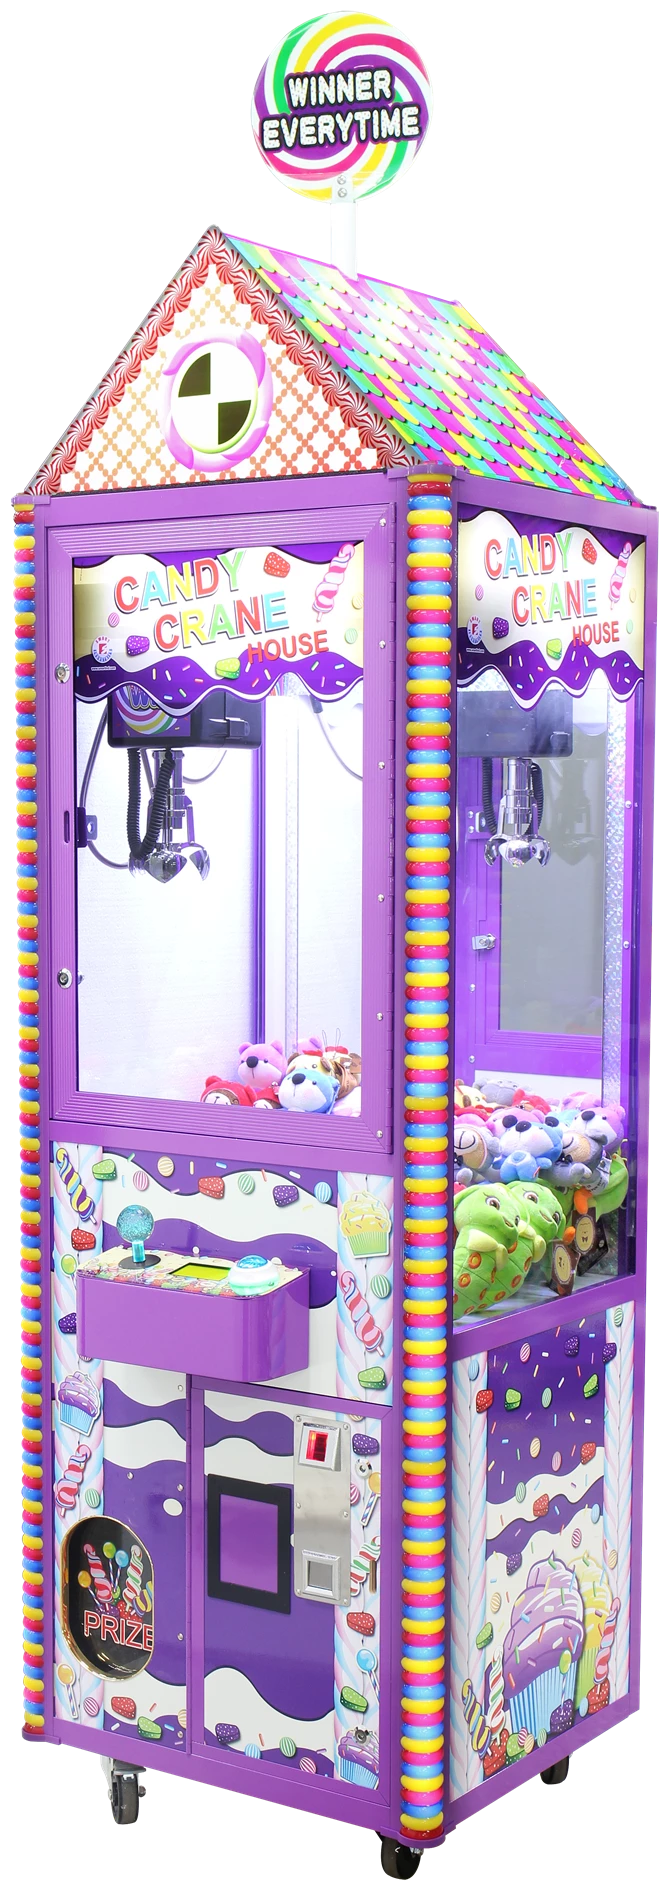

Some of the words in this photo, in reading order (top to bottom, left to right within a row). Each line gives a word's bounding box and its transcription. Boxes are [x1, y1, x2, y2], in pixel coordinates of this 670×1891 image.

[287, 69, 393, 108] WINNER
[262, 105, 421, 150] EVERYTIME
[484, 531, 574, 580] CANDY
[114, 550, 246, 614] CANDY
[512, 578, 598, 627] CRANE
[154, 590, 289, 652] CRANE
[572, 620, 620, 647] HOUSE
[247, 629, 330, 664] HOUSE
[83, 1610, 153, 1652] PRIZE
